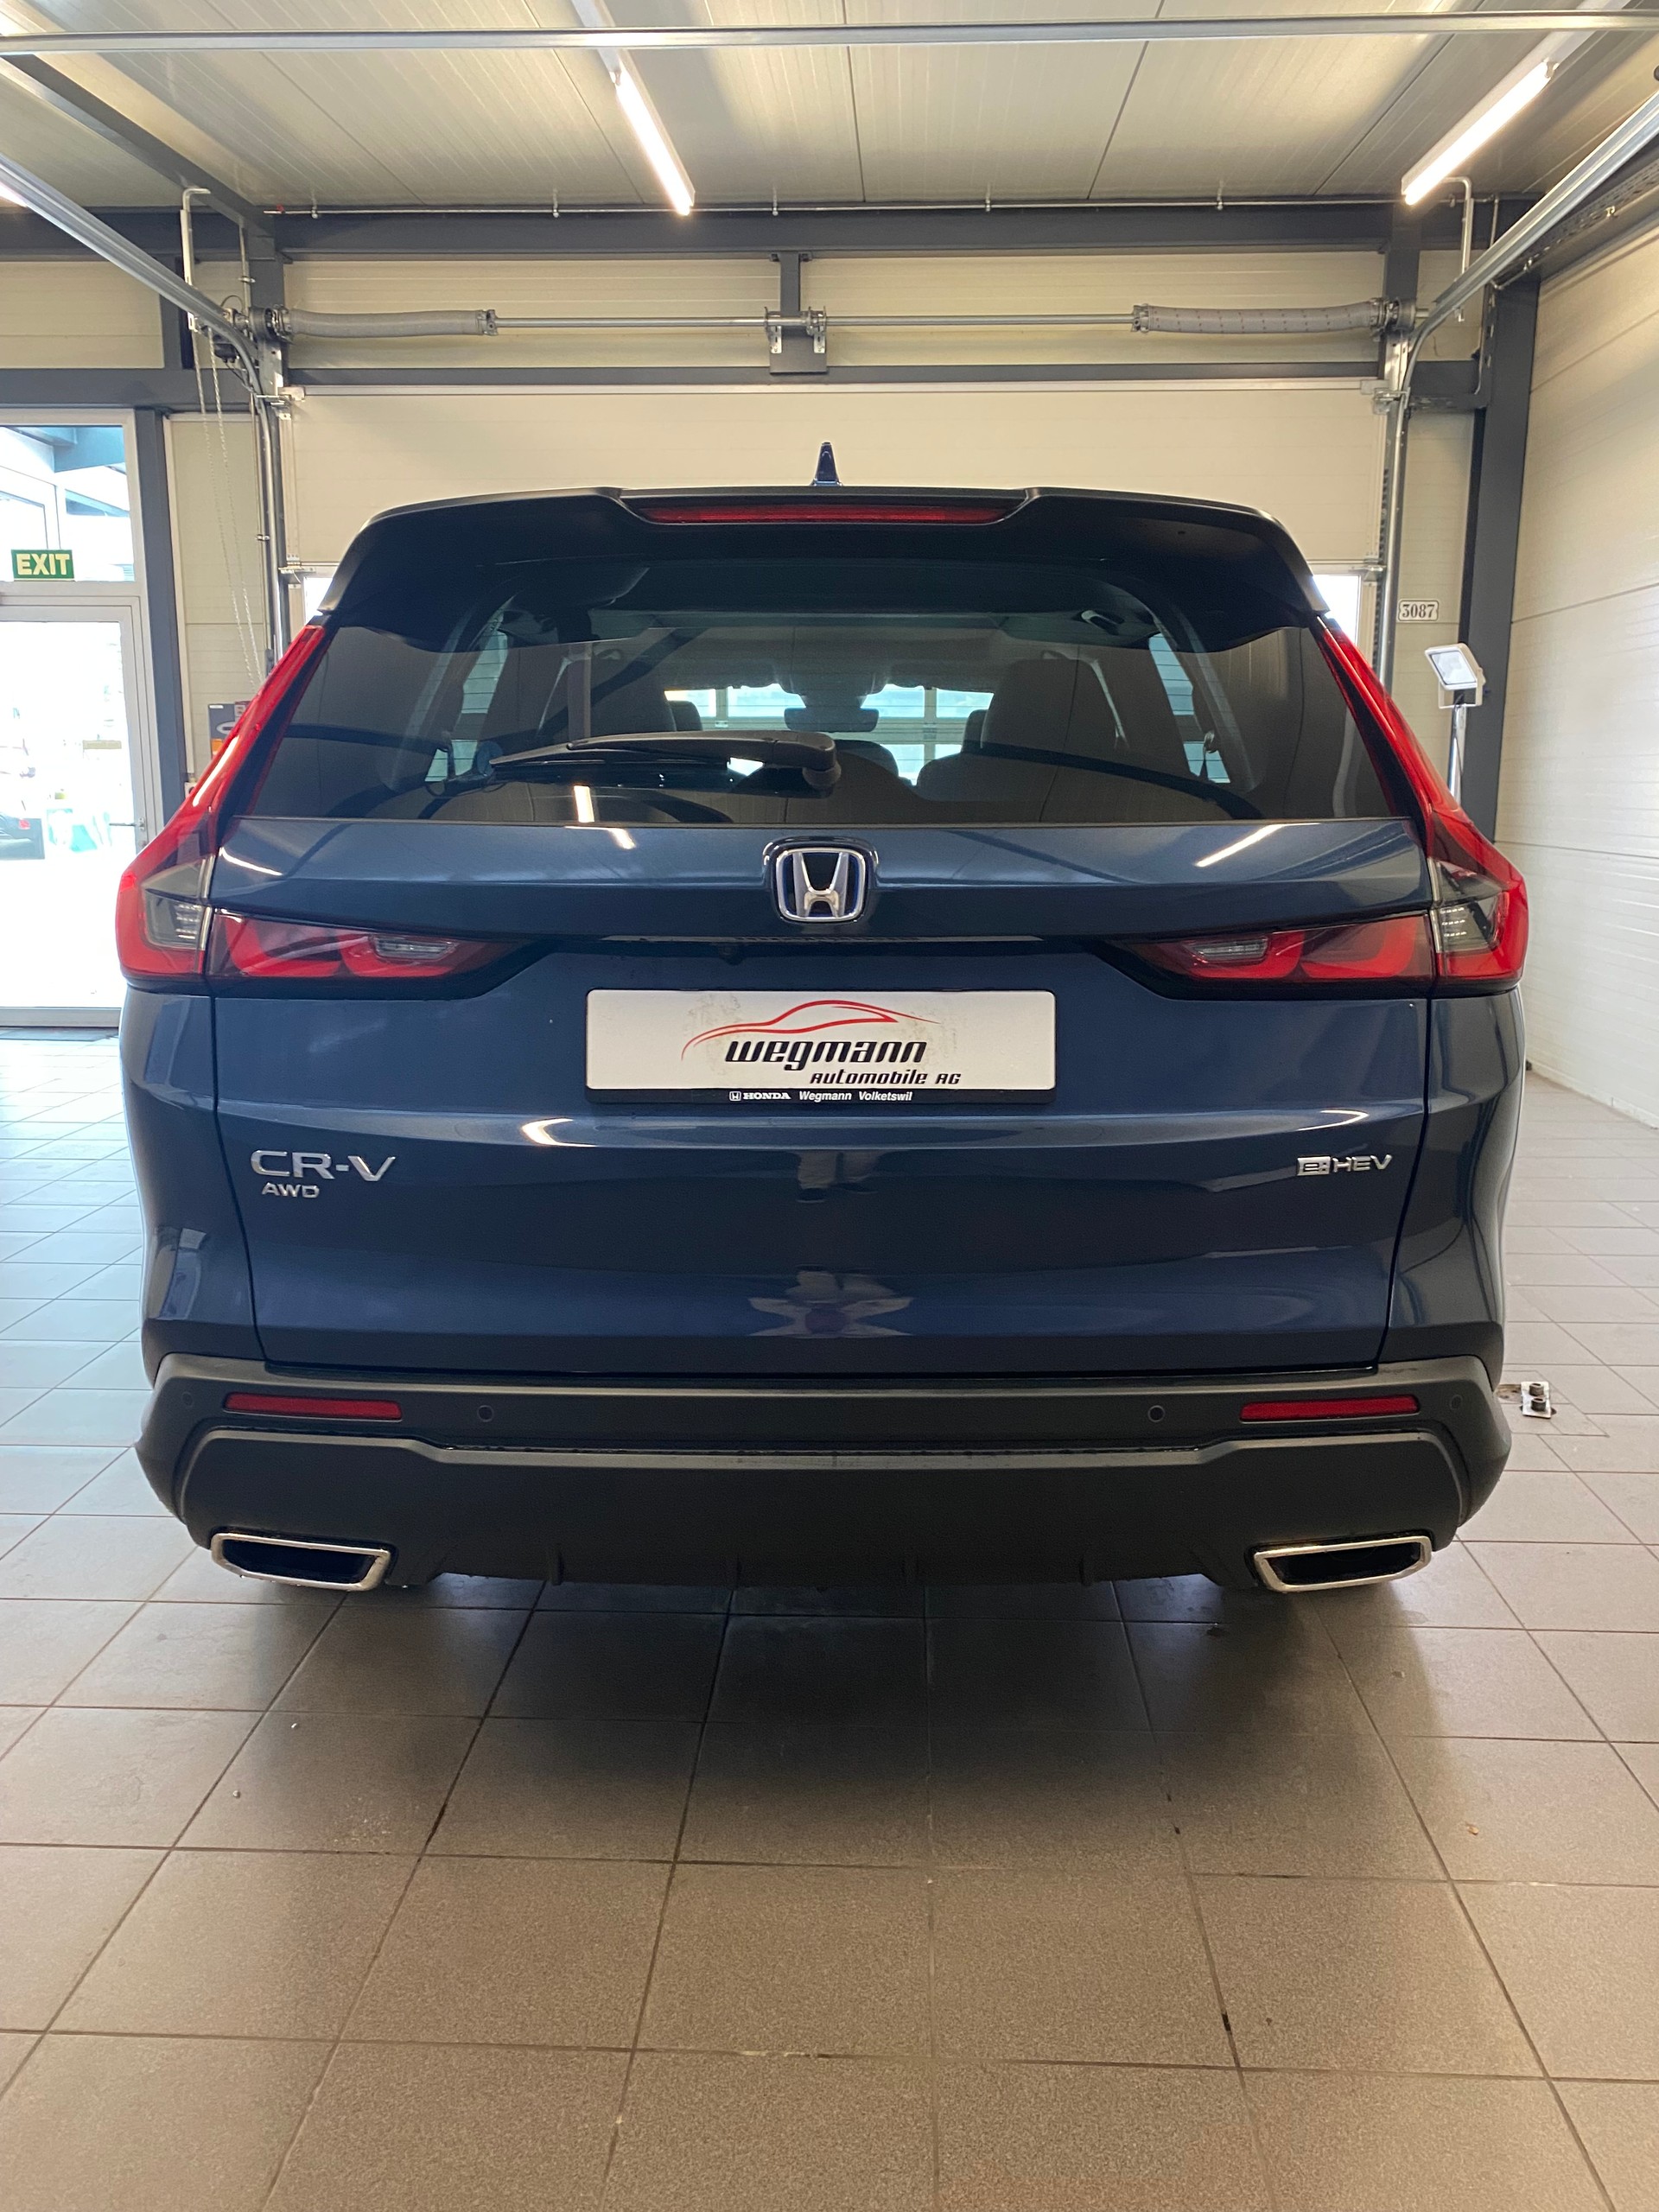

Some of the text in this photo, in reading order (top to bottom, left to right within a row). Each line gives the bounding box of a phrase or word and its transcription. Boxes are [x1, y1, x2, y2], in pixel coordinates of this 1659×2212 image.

[16, 553, 70, 575] EXIT
[1402, 603, 1435, 618] 3087
[725, 1041, 927, 1071] wegmann
[810, 1069, 961, 1084] automobile AG
[743, 1091, 791, 1100] HONDA
[798, 1090, 852, 1103] Wegmann
[858, 1090, 913, 1101] Volketswil
[251, 1149, 397, 1181] CR-V
[262, 1182, 320, 1198] AWD
